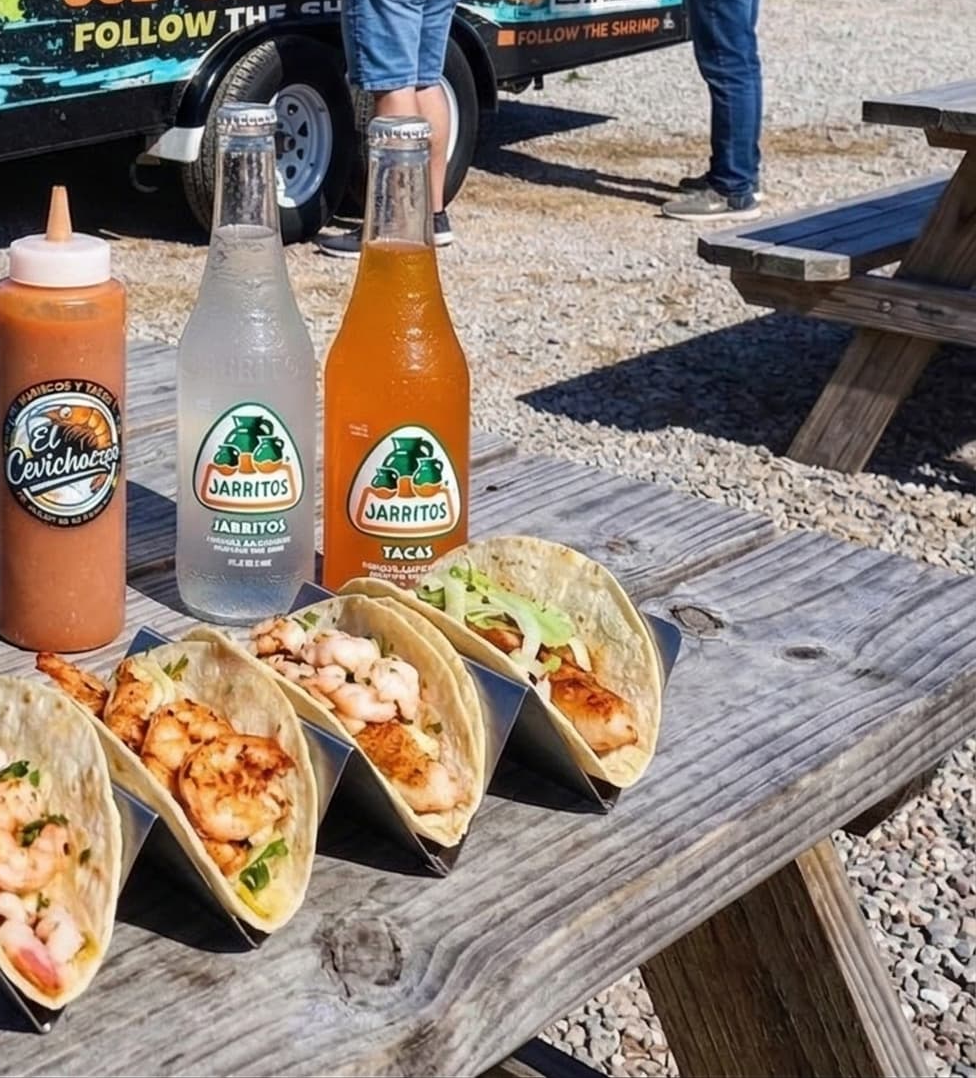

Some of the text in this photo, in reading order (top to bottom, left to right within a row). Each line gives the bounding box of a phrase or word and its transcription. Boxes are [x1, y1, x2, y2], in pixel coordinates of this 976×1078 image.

[74, 9, 217, 53] FOLLOW
[517, 17, 660, 46] FOLLOW THE SHRIMP
[31, 424, 61, 452] El
[209, 478, 288, 498] JARRITOS
[365, 502, 447, 521] JARRITOS
